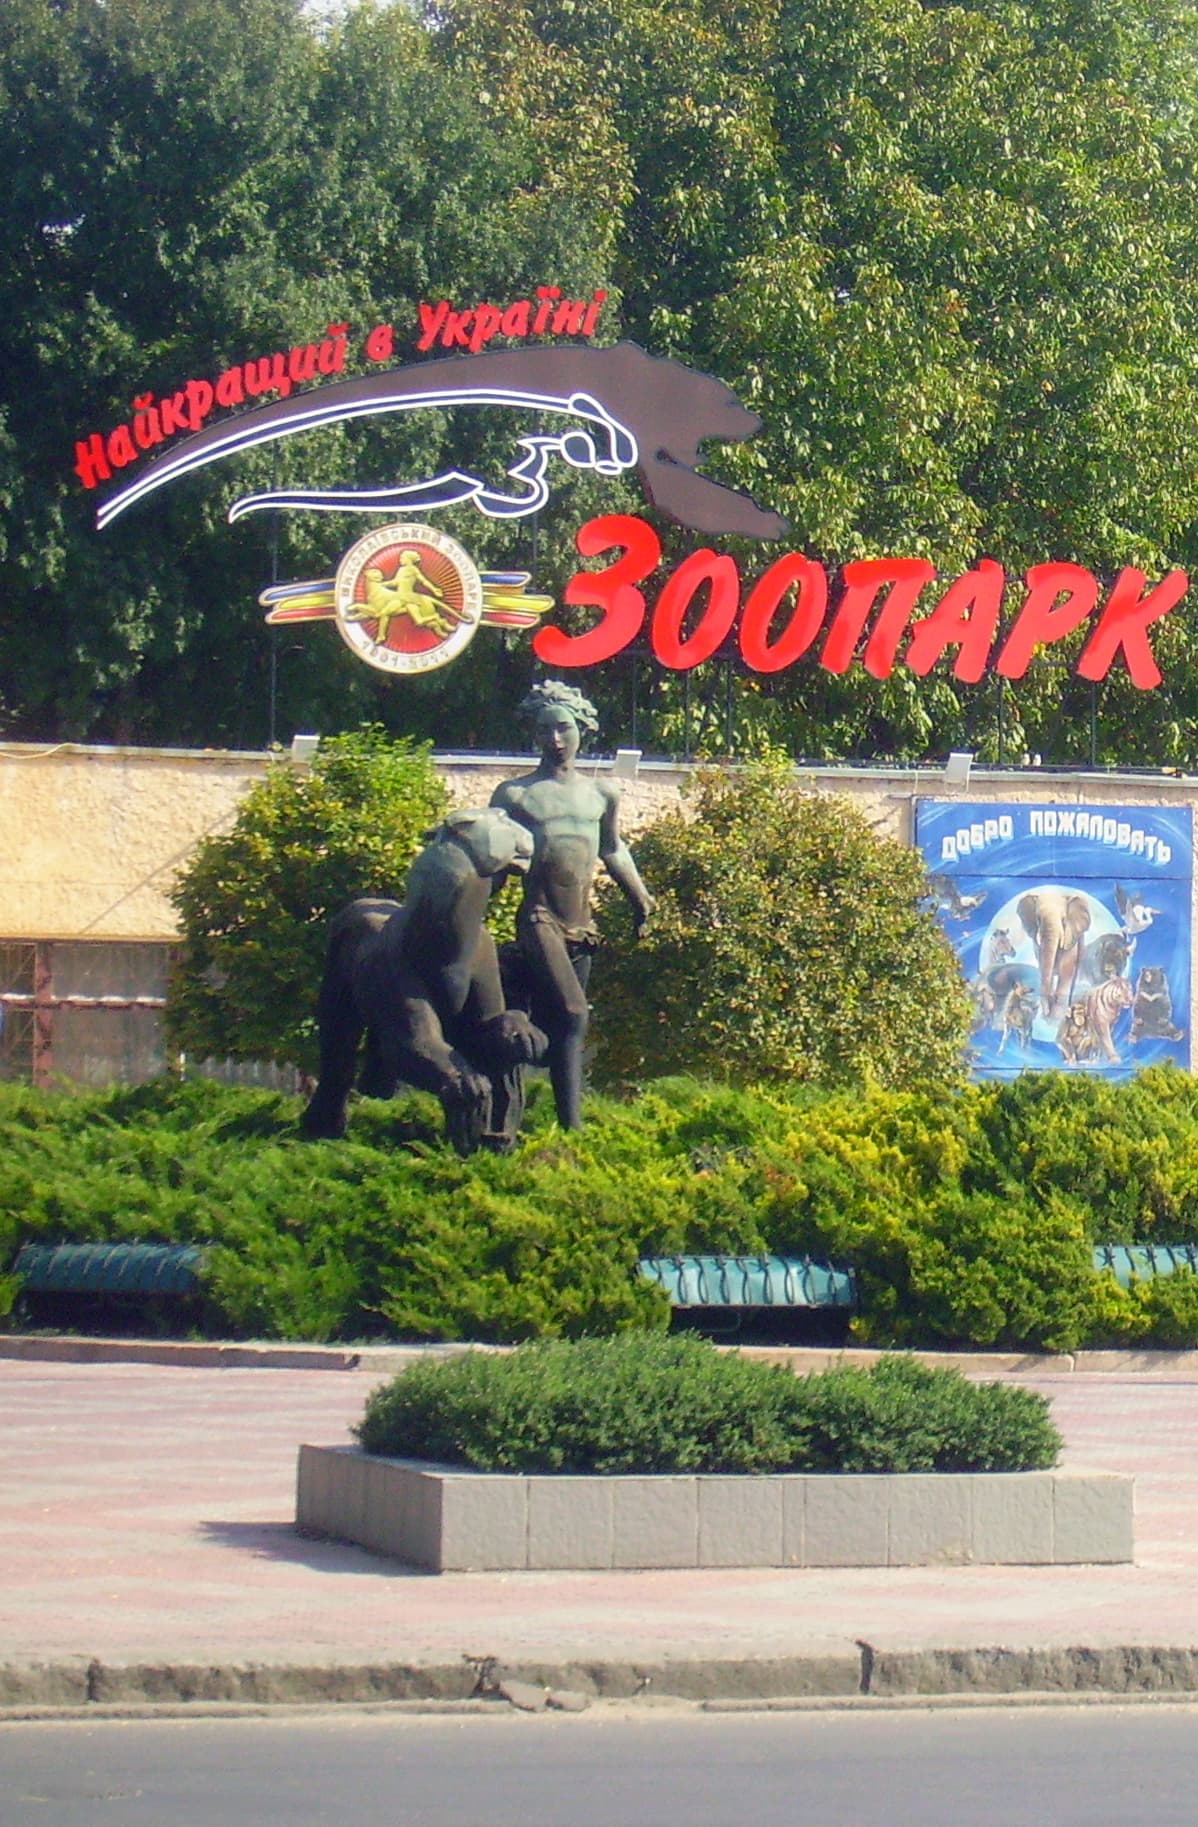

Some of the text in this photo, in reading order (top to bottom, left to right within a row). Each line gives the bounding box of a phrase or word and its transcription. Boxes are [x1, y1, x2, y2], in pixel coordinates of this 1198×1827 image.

[75, 287, 608, 489] Найкращий в Україні
[532, 514, 1190, 691] ЗООПАРК
[941, 810, 1172, 865] ДОБРО ПОЖАЛОВАТЬ
